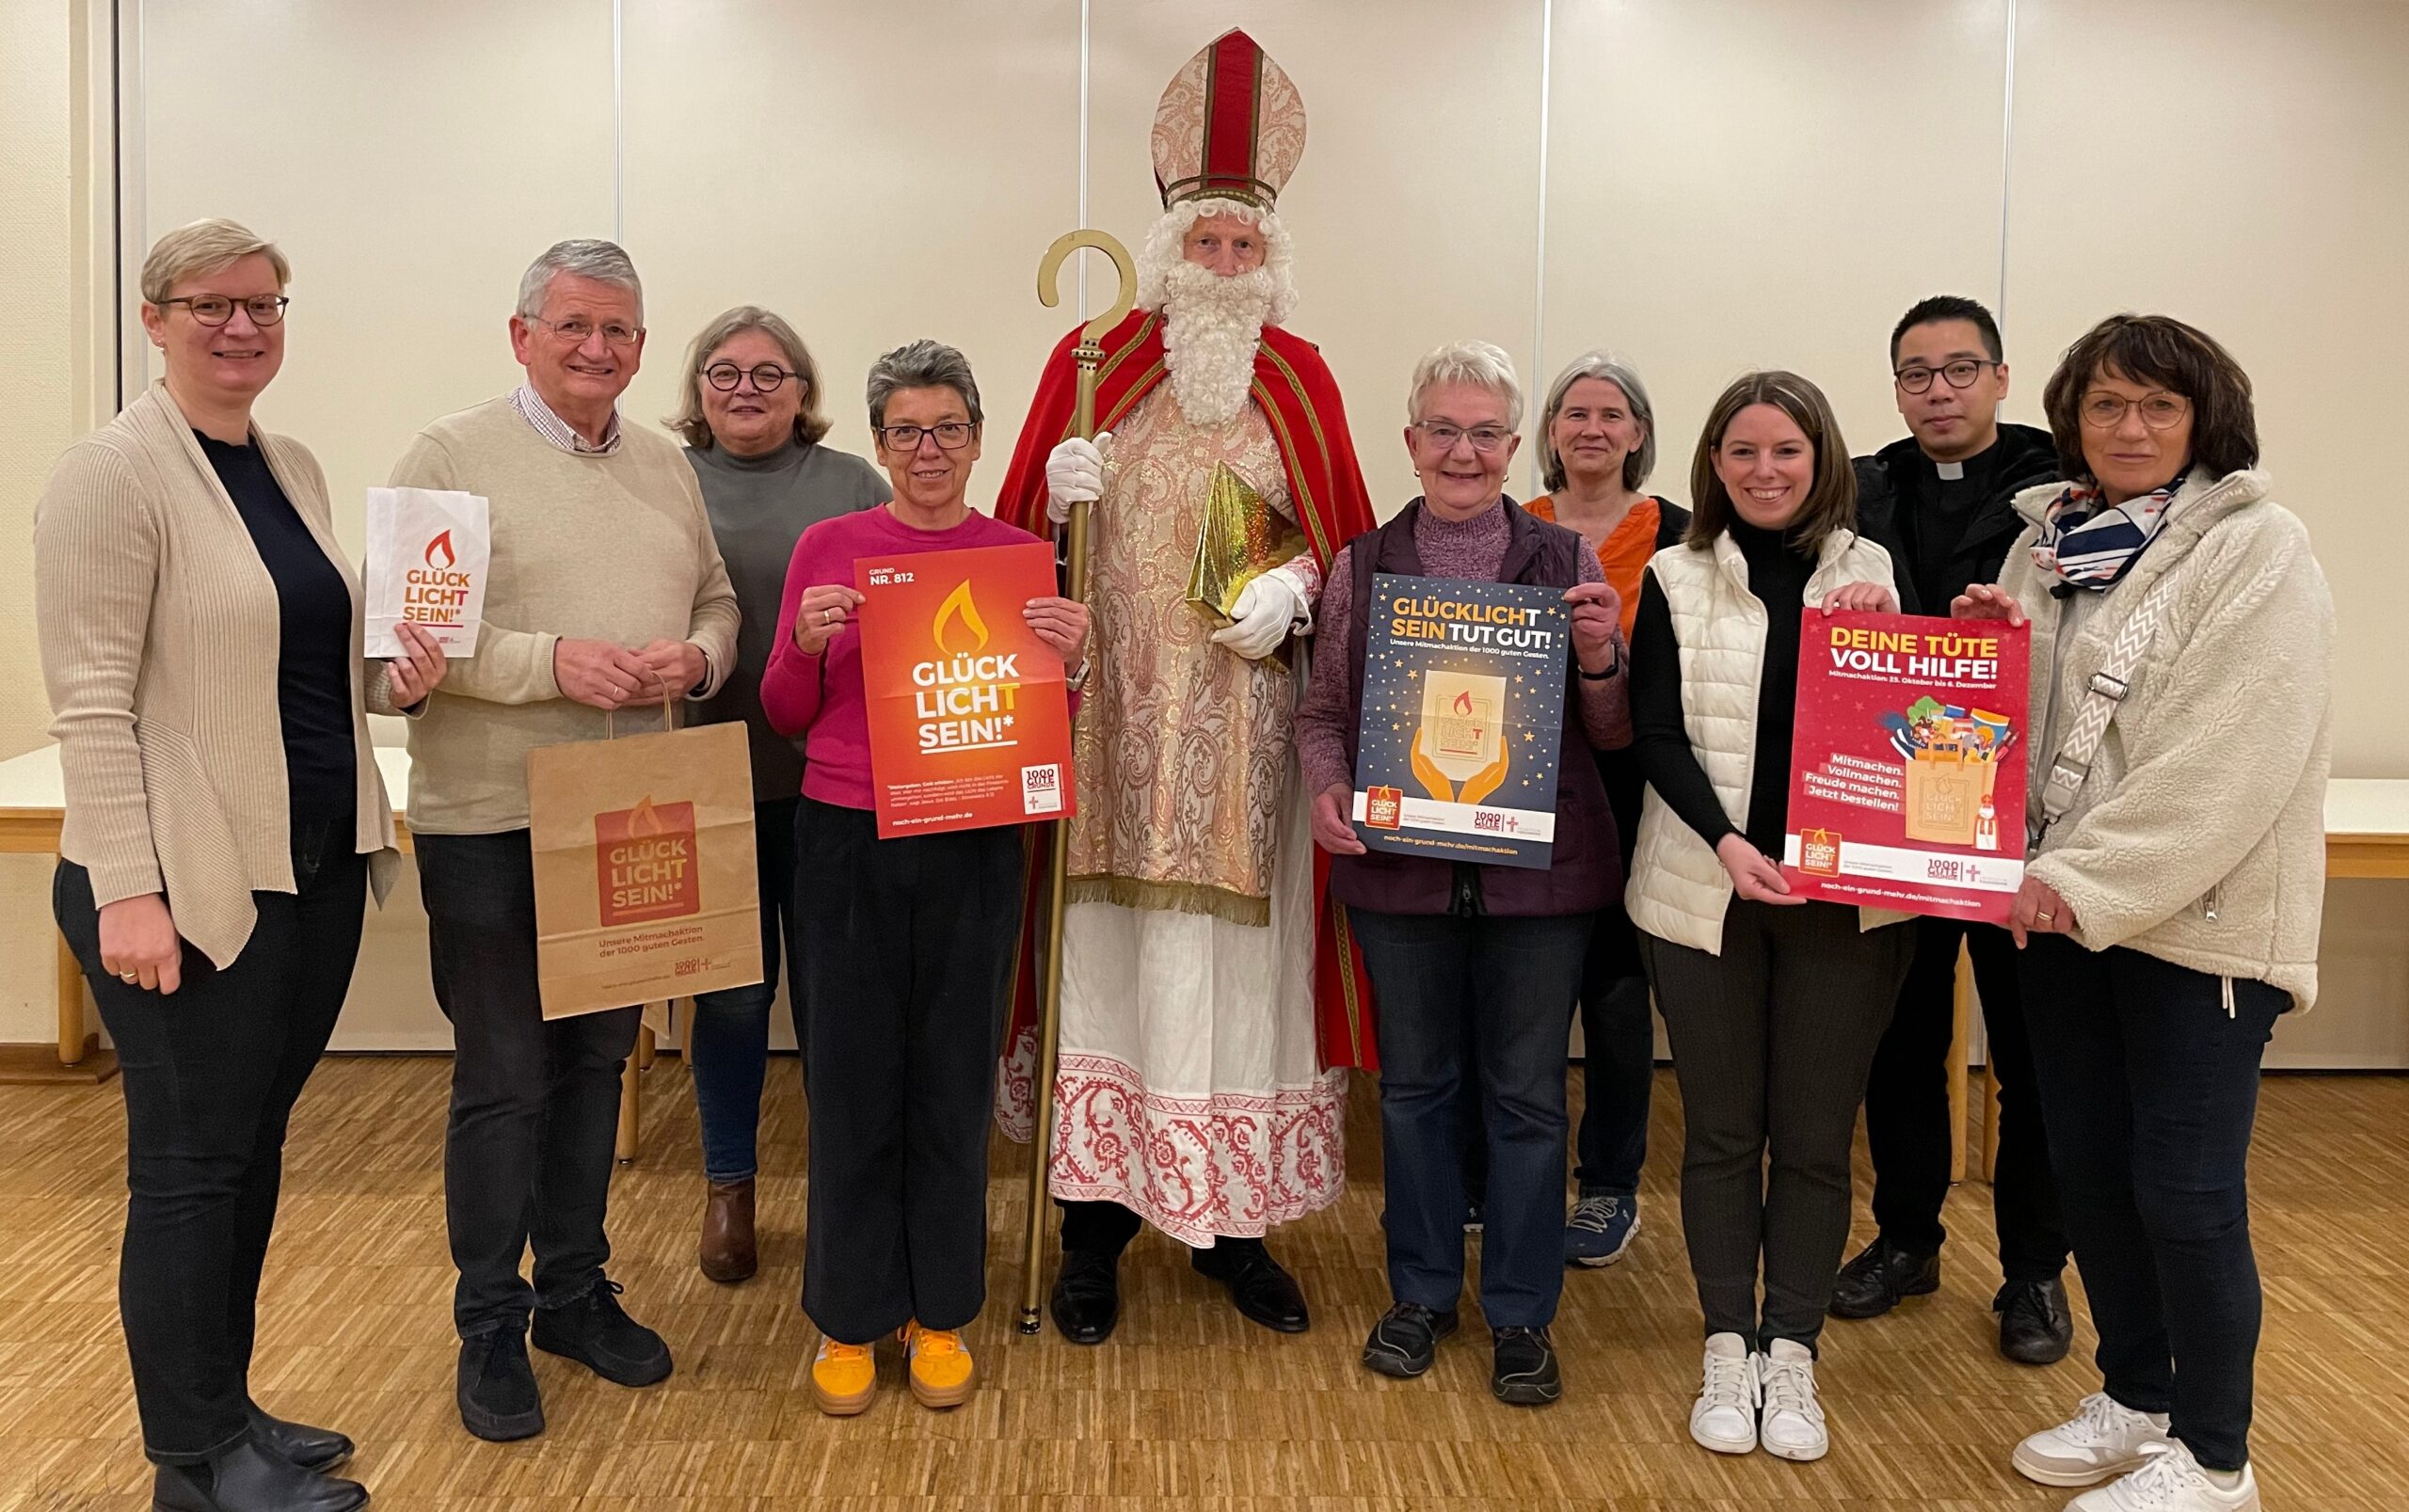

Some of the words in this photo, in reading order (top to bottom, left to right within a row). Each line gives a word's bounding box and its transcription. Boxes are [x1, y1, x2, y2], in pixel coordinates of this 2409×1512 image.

[407, 567, 471, 587] GLÜCK
[870, 575, 892, 585] NR.
[894, 572, 915, 583] 812
[405, 587, 469, 606] LICHT
[1393, 595, 1541, 627] GLÜCKLICHT
[1391, 618, 1445, 640] SEIN
[1448, 623, 1494, 644] TUT
[1496, 628, 1552, 649] GUT!
[1830, 627, 1918, 654] DEINE
[1924, 632, 1998, 658] TÜTE
[1390, 638, 1414, 647] Unsere
[1414, 641, 1468, 652] Mitmachaktion
[1482, 646, 1500, 655] 1000
[1501, 648, 1523, 657] guten
[1523, 650, 1550, 660] Gesten.
[912, 651, 1020, 687] GLÜCK
[1830, 647, 1901, 674] VOLL
[1908, 656, 1998, 680] HILFE!
[1828, 669, 1888, 682] Mitmachaktion:
[1902, 676, 1933, 687] Oktober
[1935, 678, 1946, 687] bis
[1956, 680, 1996, 690] Dezember
[916, 683, 1021, 719] LICHT
[1026, 768, 1054, 779] 1000
[1832, 754, 1904, 775] Mitmachen.
[1806, 772, 1846, 788] Freude
[1848, 783, 1900, 800] machen.
[1827, 764, 1902, 788] Vollmachen.
[1809, 785, 1839, 800] Jetzt
[1841, 791, 1899, 811] bestellen!
[892, 812, 973, 827] noch-ein-grund-mehr.de
[1371, 806, 1397, 815] LICHT
[1476, 811, 1501, 821] 1000
[611, 839, 687, 865] GLÜCK
[1805, 851, 1836, 862] LICHT
[612, 859, 687, 887] LICHT
[1928, 858, 1959, 870] 1000
[598, 937, 631, 947] Unsere
[633, 926, 703, 942] Mitmachaktion
[599, 949, 615, 958] der
[617, 945, 641, 955] 1000
[642, 941, 670, 952] guten
